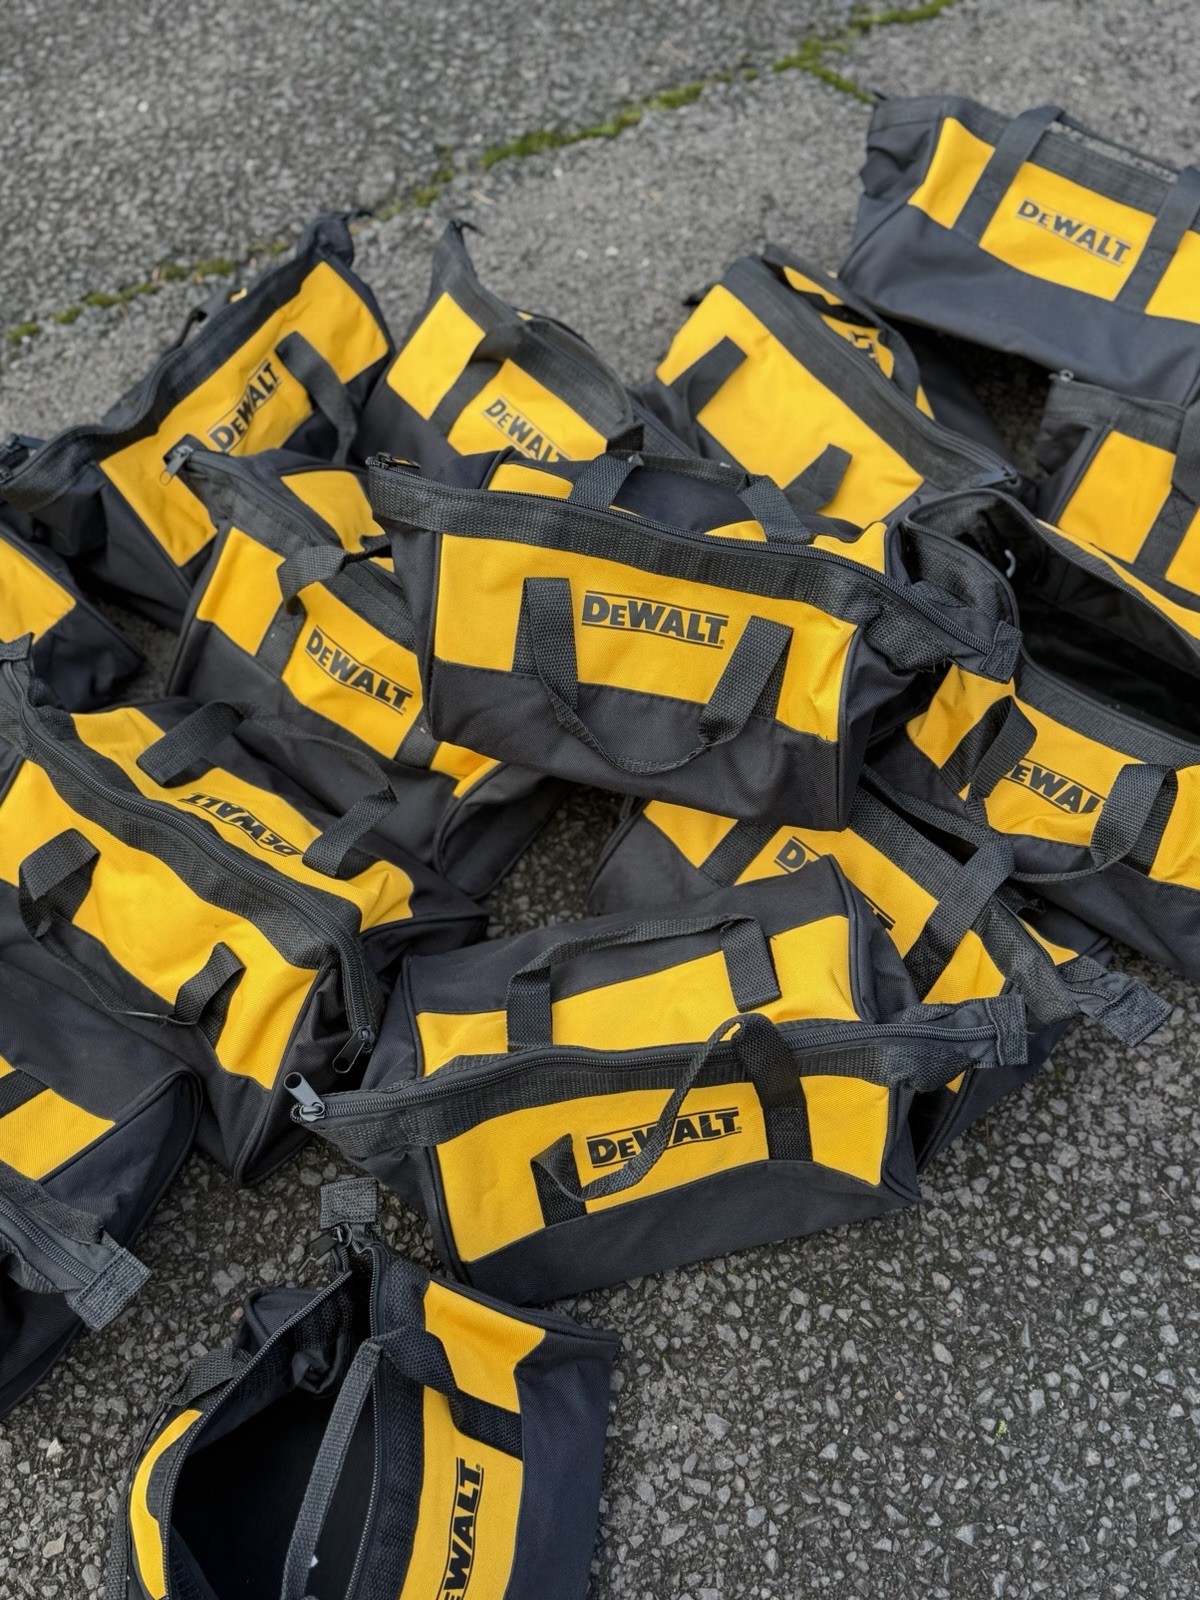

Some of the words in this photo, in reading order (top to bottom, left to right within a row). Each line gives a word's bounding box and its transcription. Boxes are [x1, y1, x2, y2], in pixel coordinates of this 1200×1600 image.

[1018, 200, 1131, 263] DEWALT
[209, 362, 277, 451] DEWALT
[485, 399, 567, 462] DEWAL
[582, 594, 728, 644] DEWALT
[306, 628, 413, 709] DEWALT
[1010, 764, 1100, 814] EWAL
[184, 794, 302, 856] DEWALT
